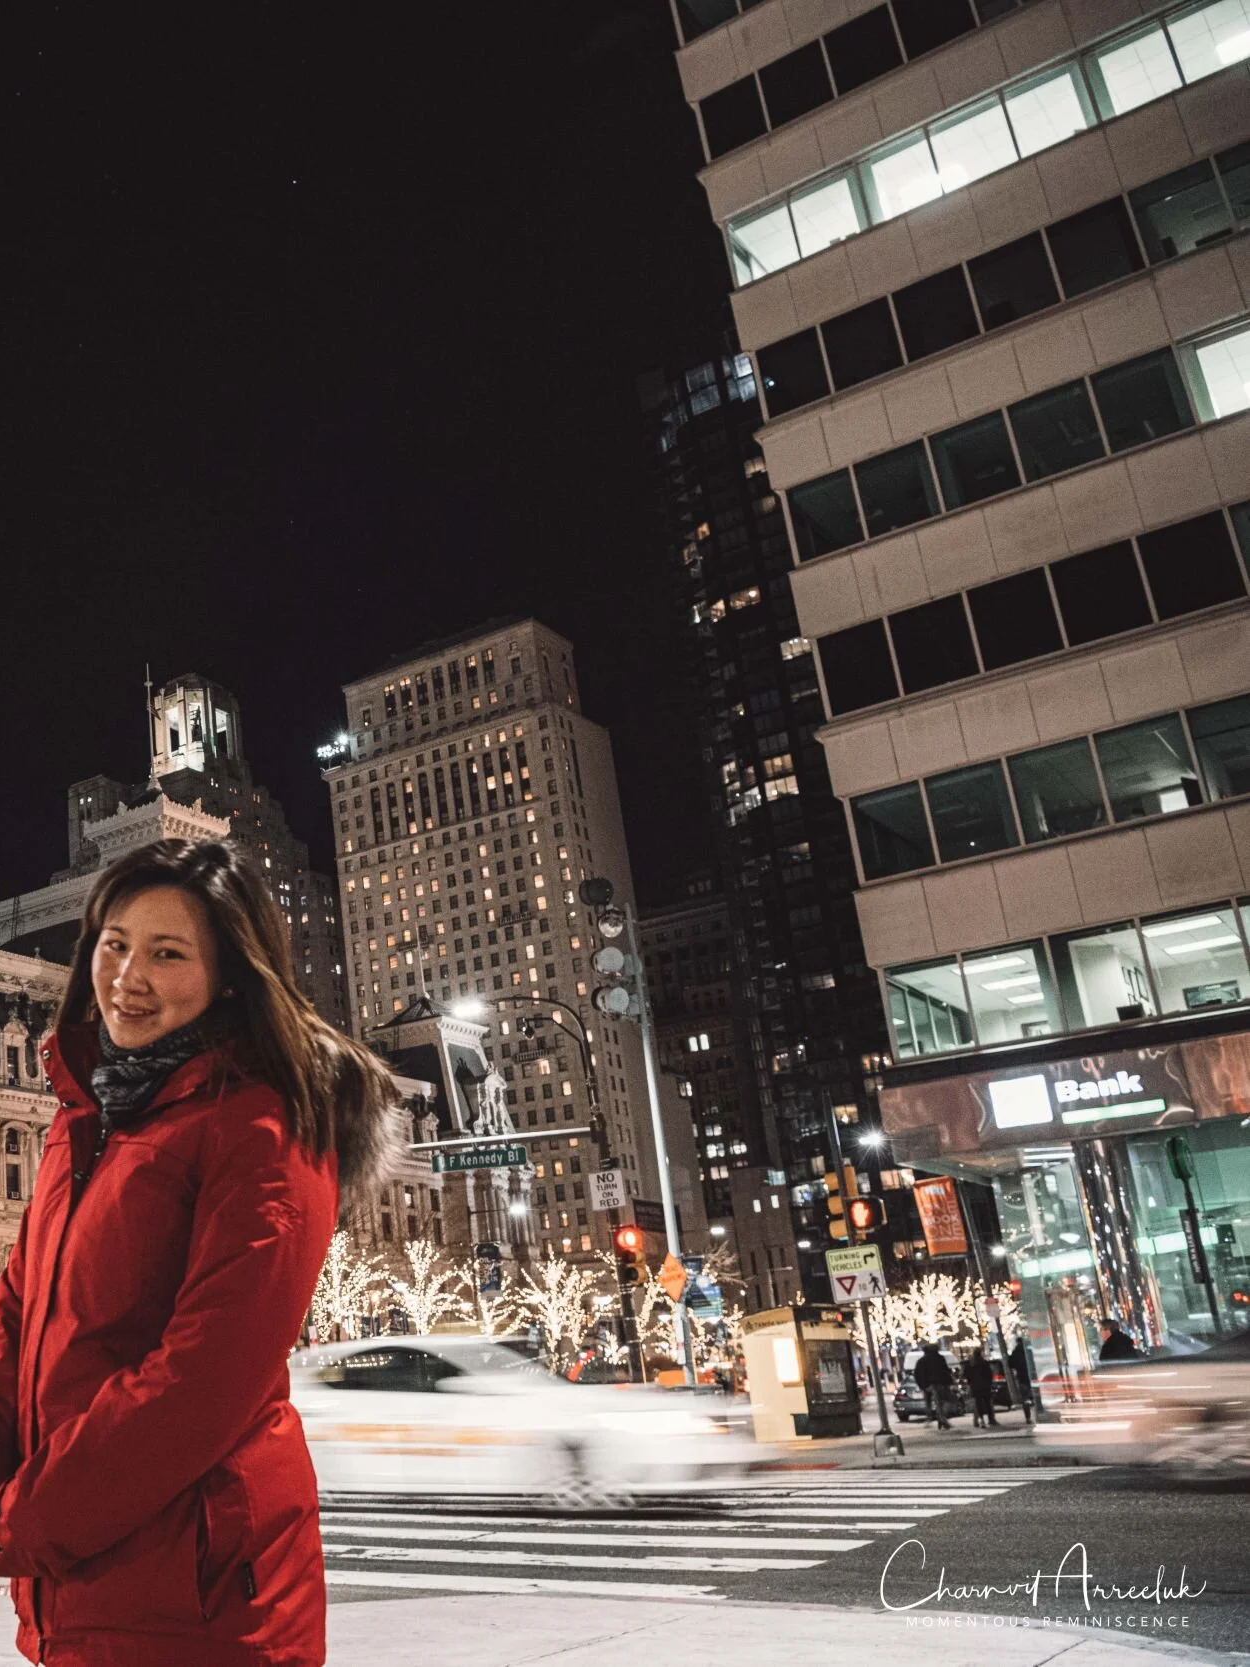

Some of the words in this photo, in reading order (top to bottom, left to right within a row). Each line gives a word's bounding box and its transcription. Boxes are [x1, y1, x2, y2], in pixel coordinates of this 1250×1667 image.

[1054, 1071, 1144, 1103] Bank
[450, 1156, 455, 1167] F
[460, 1153, 503, 1166] Kennedy
[596, 1173, 615, 1184] NO
[596, 1183, 618, 1191] TURN
[599, 1198, 620, 1207] RED
[830, 1251, 860, 1261] TURNING
[832, 1261, 862, 1271] VEHICLES
